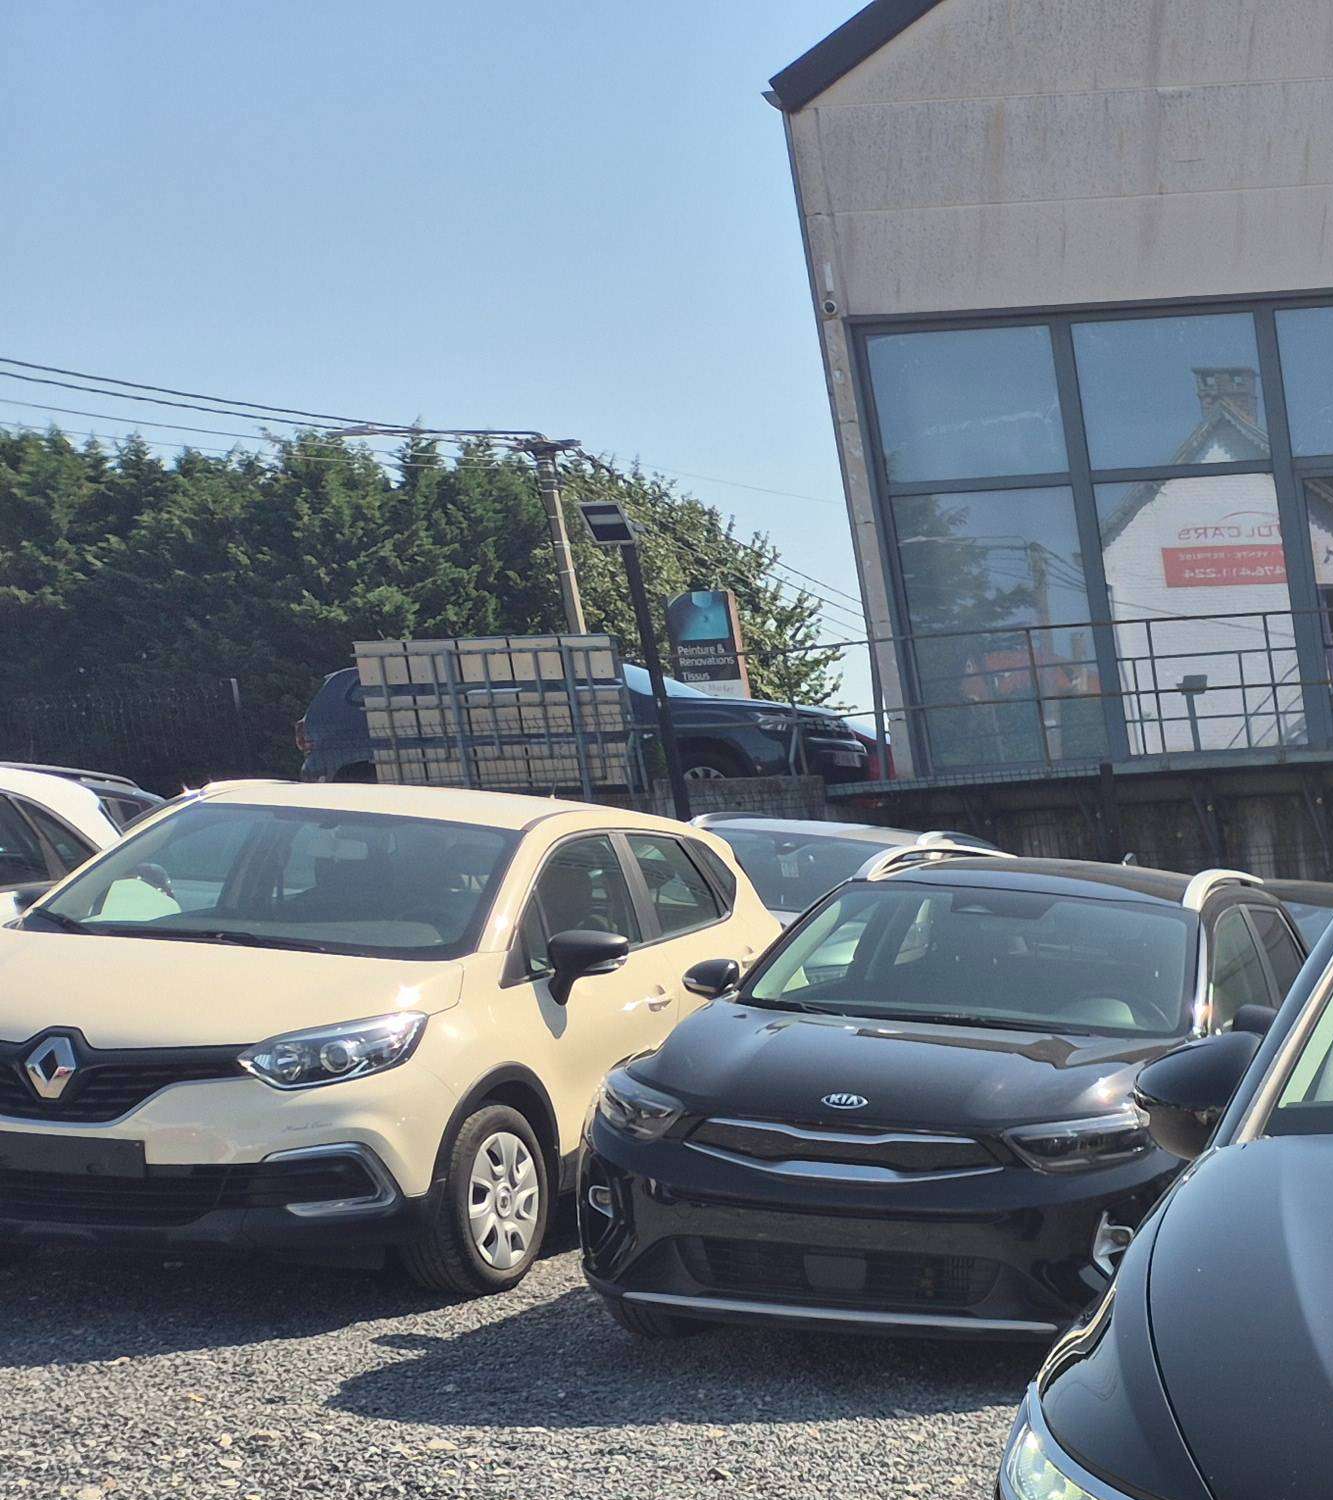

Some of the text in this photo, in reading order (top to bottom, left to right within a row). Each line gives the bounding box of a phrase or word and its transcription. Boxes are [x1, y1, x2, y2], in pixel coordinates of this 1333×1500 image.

[677, 646, 716, 656] Peinture
[682, 672, 710, 681] Tissus
[829, 1093, 859, 1106] KIA
